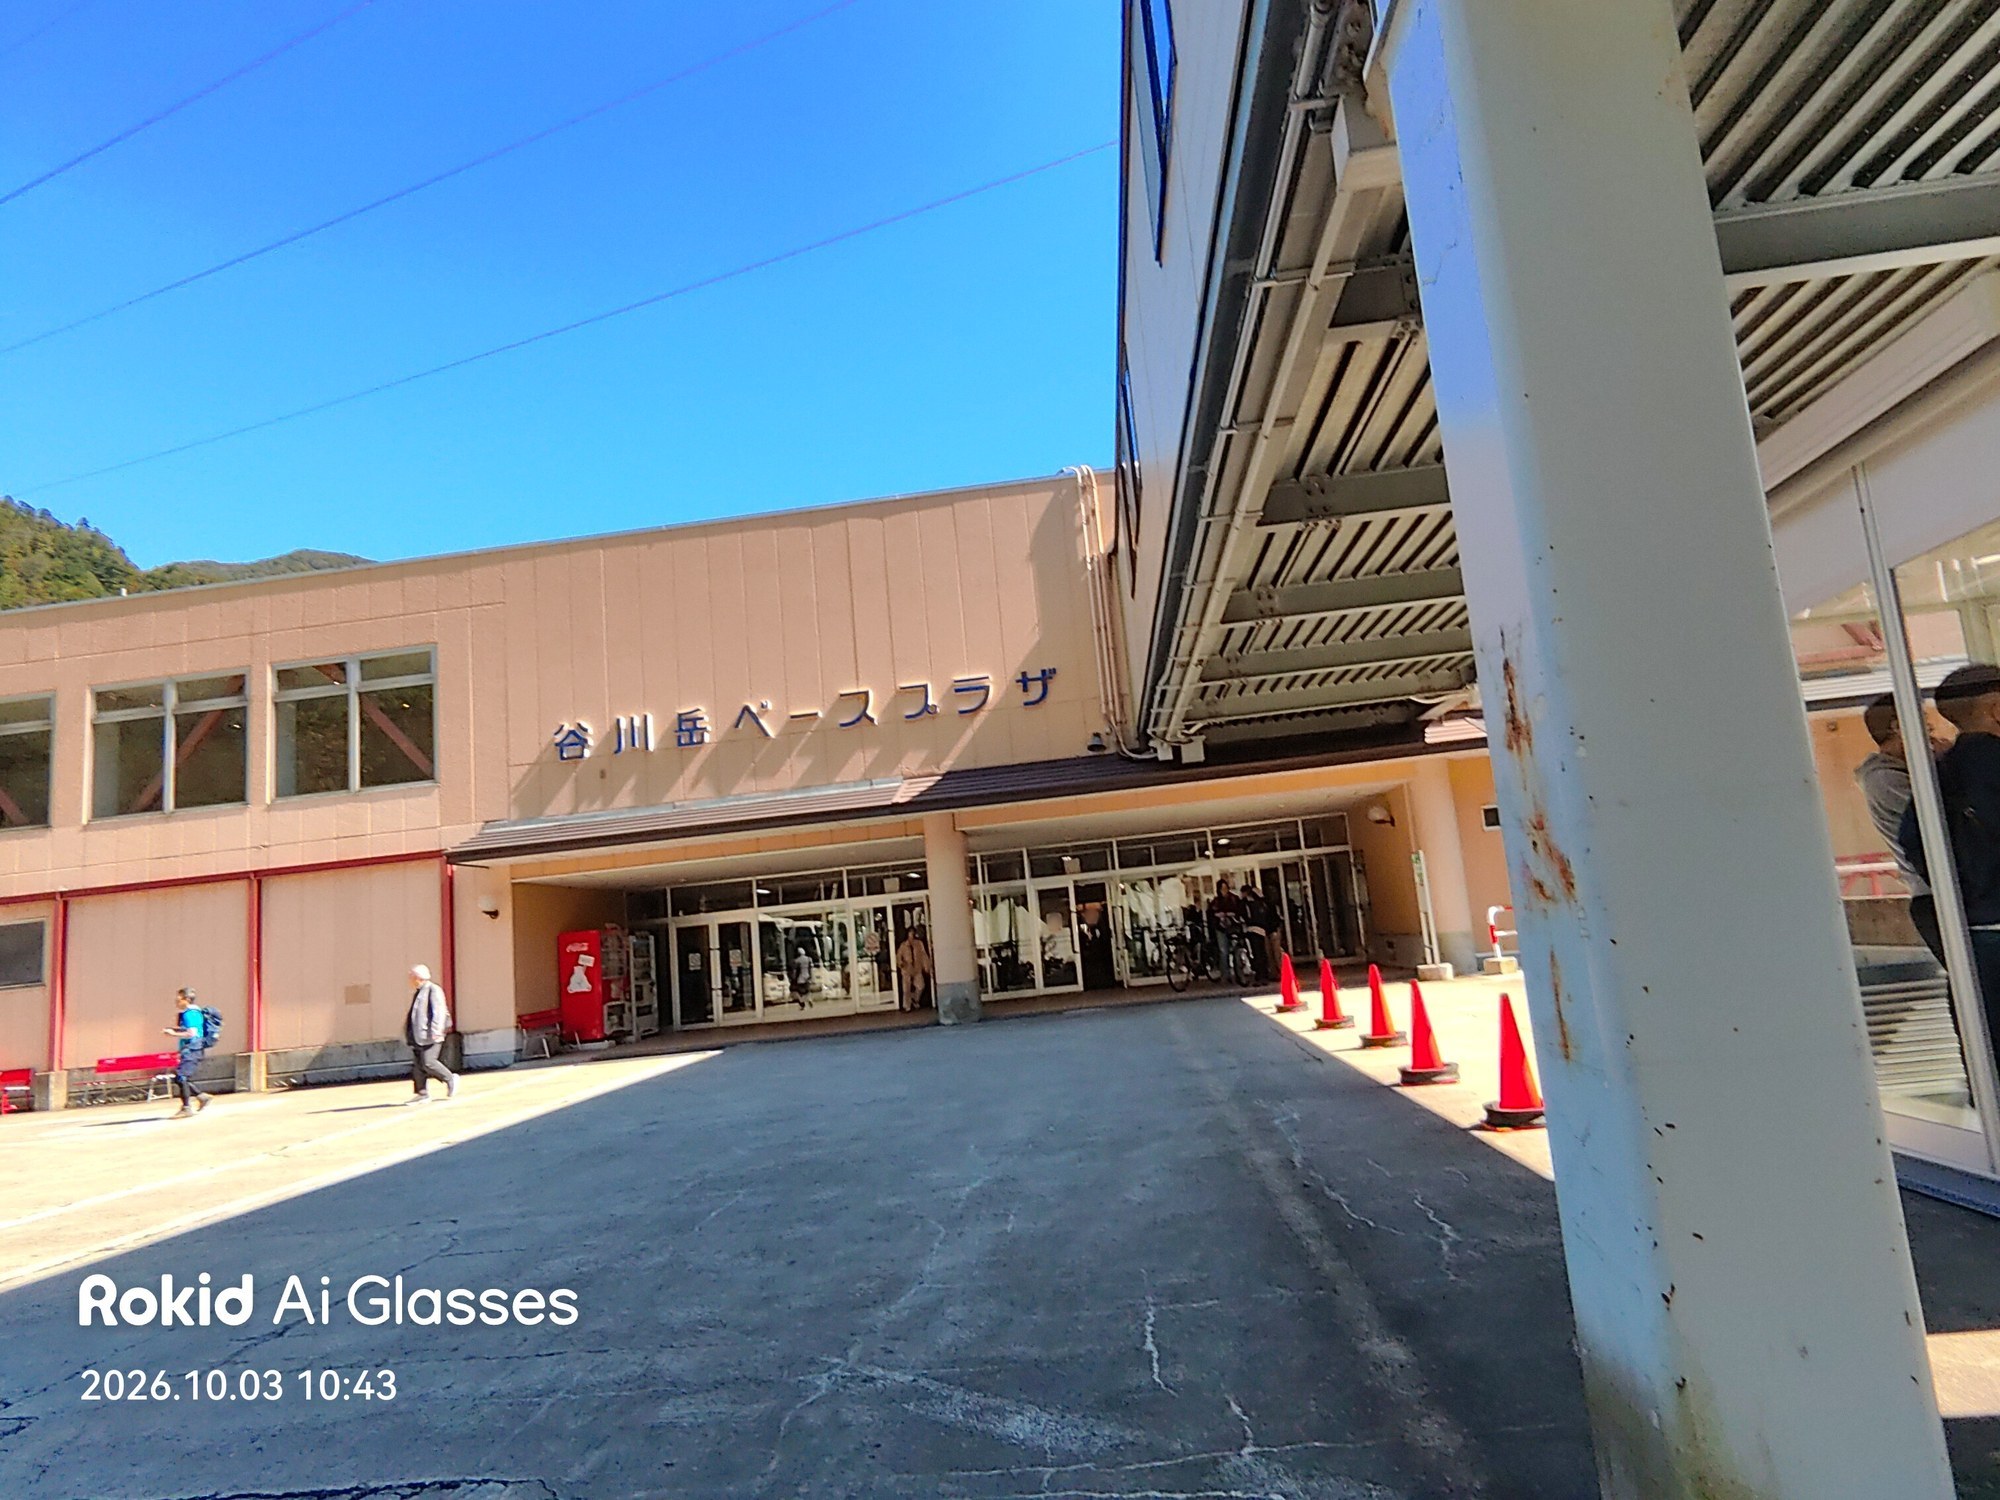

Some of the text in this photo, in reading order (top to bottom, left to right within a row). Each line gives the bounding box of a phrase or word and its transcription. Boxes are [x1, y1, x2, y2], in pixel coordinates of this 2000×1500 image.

[554, 667, 1057, 761] 谷川岳ベースプラザ
